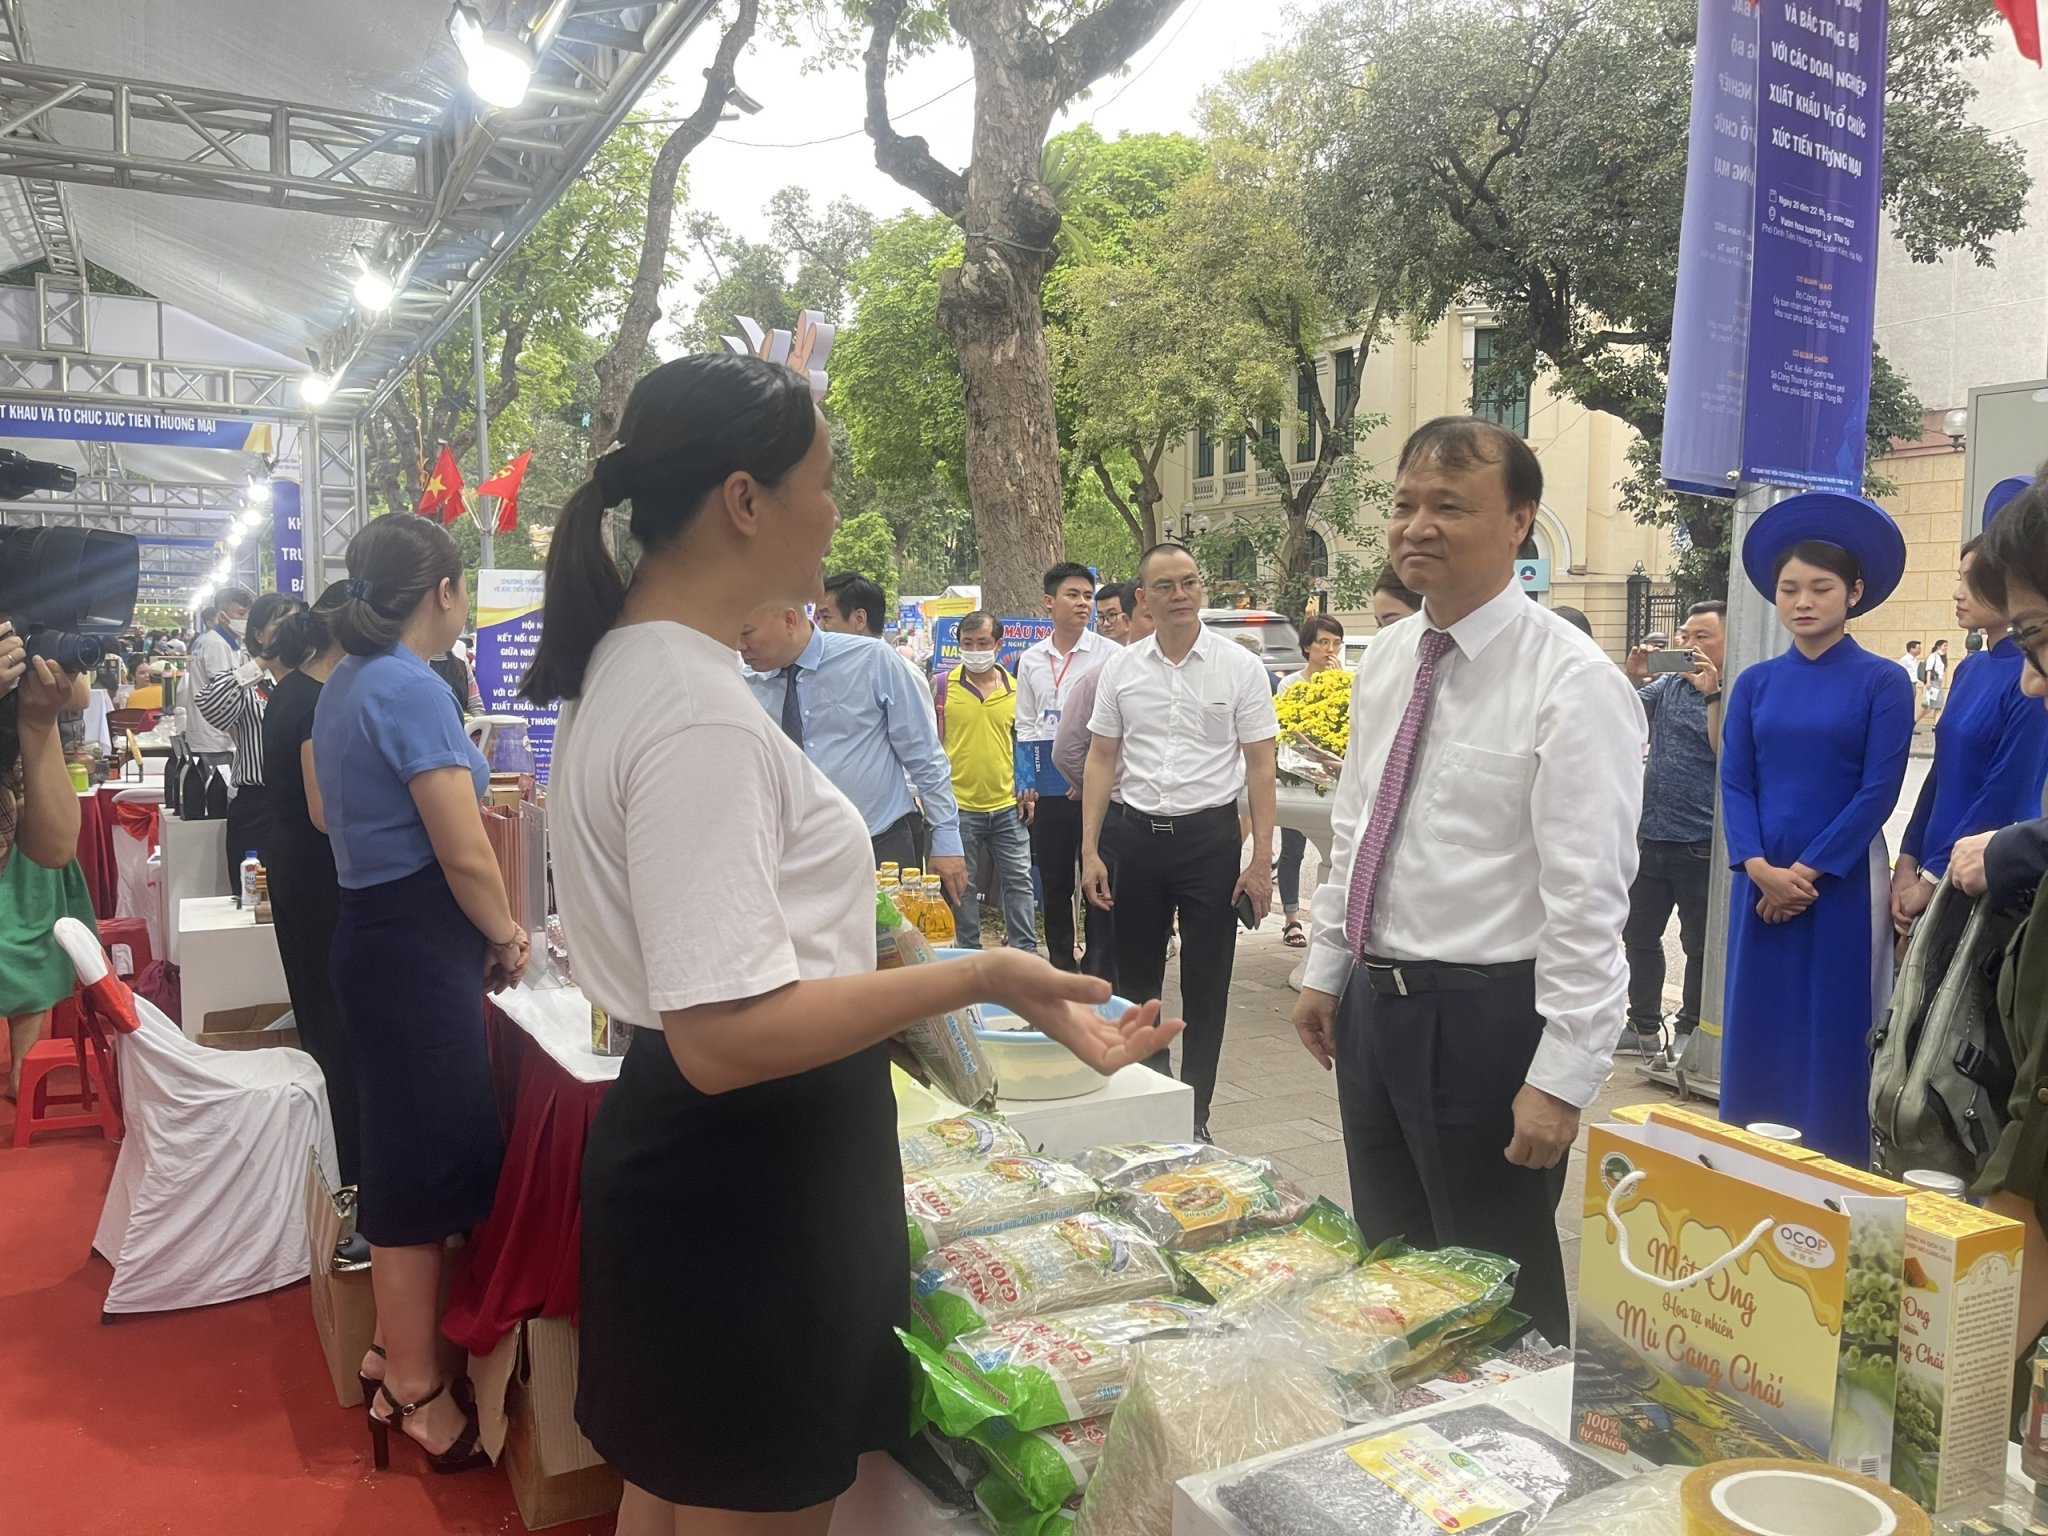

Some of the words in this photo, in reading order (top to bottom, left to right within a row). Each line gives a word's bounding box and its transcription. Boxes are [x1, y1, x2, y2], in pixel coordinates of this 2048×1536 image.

[1800, 6, 1818, 33] BẮC
[1820, 20, 1845, 47] TRG
[1771, 40, 1788, 63] VỚI
[1789, 47, 1808, 71] CÁC
[1810, 57, 1834, 85] DOA
[1769, 83, 1794, 107] XUẤT
[1796, 91, 1820, 118] KHẨU
[1847, 115, 1866, 138] CHỨC
[1772, 126, 1791, 149] XÚC
[1792, 134, 1813, 157] TIẾN
[1848, 155, 1862, 179] MẠI
[1809, 205, 1818, 214] 22
[1827, 213, 1832, 221] 5
[496, 632, 512, 643] KẾT
[514, 632, 528, 643] NỐI
[521, 620, 535, 631] HỘI
[500, 646, 519, 656] GIỮA
[520, 647, 536, 656] NHÀ
[503, 674, 513, 683] VÀ
[492, 700, 511, 711] XUẤT
[493, 688, 506, 697] VỚI
[1780, 1226, 1829, 1252] OCOP
[1662, 1291, 1688, 1318] Hoa
[1690, 1306, 1702, 1329] tự
[1705, 1313, 1735, 1340] nhiên
[1902, 1296, 1931, 1331] Ong
[1616, 1299, 1661, 1351] Mù
[1665, 1324, 1723, 1394] Cang
[1729, 1353, 1785, 1409] Chải
[1586, 1411, 1619, 1436] 100%
[1579, 1426, 1591, 1442] tự
[1593, 1433, 1627, 1452] nhiên
